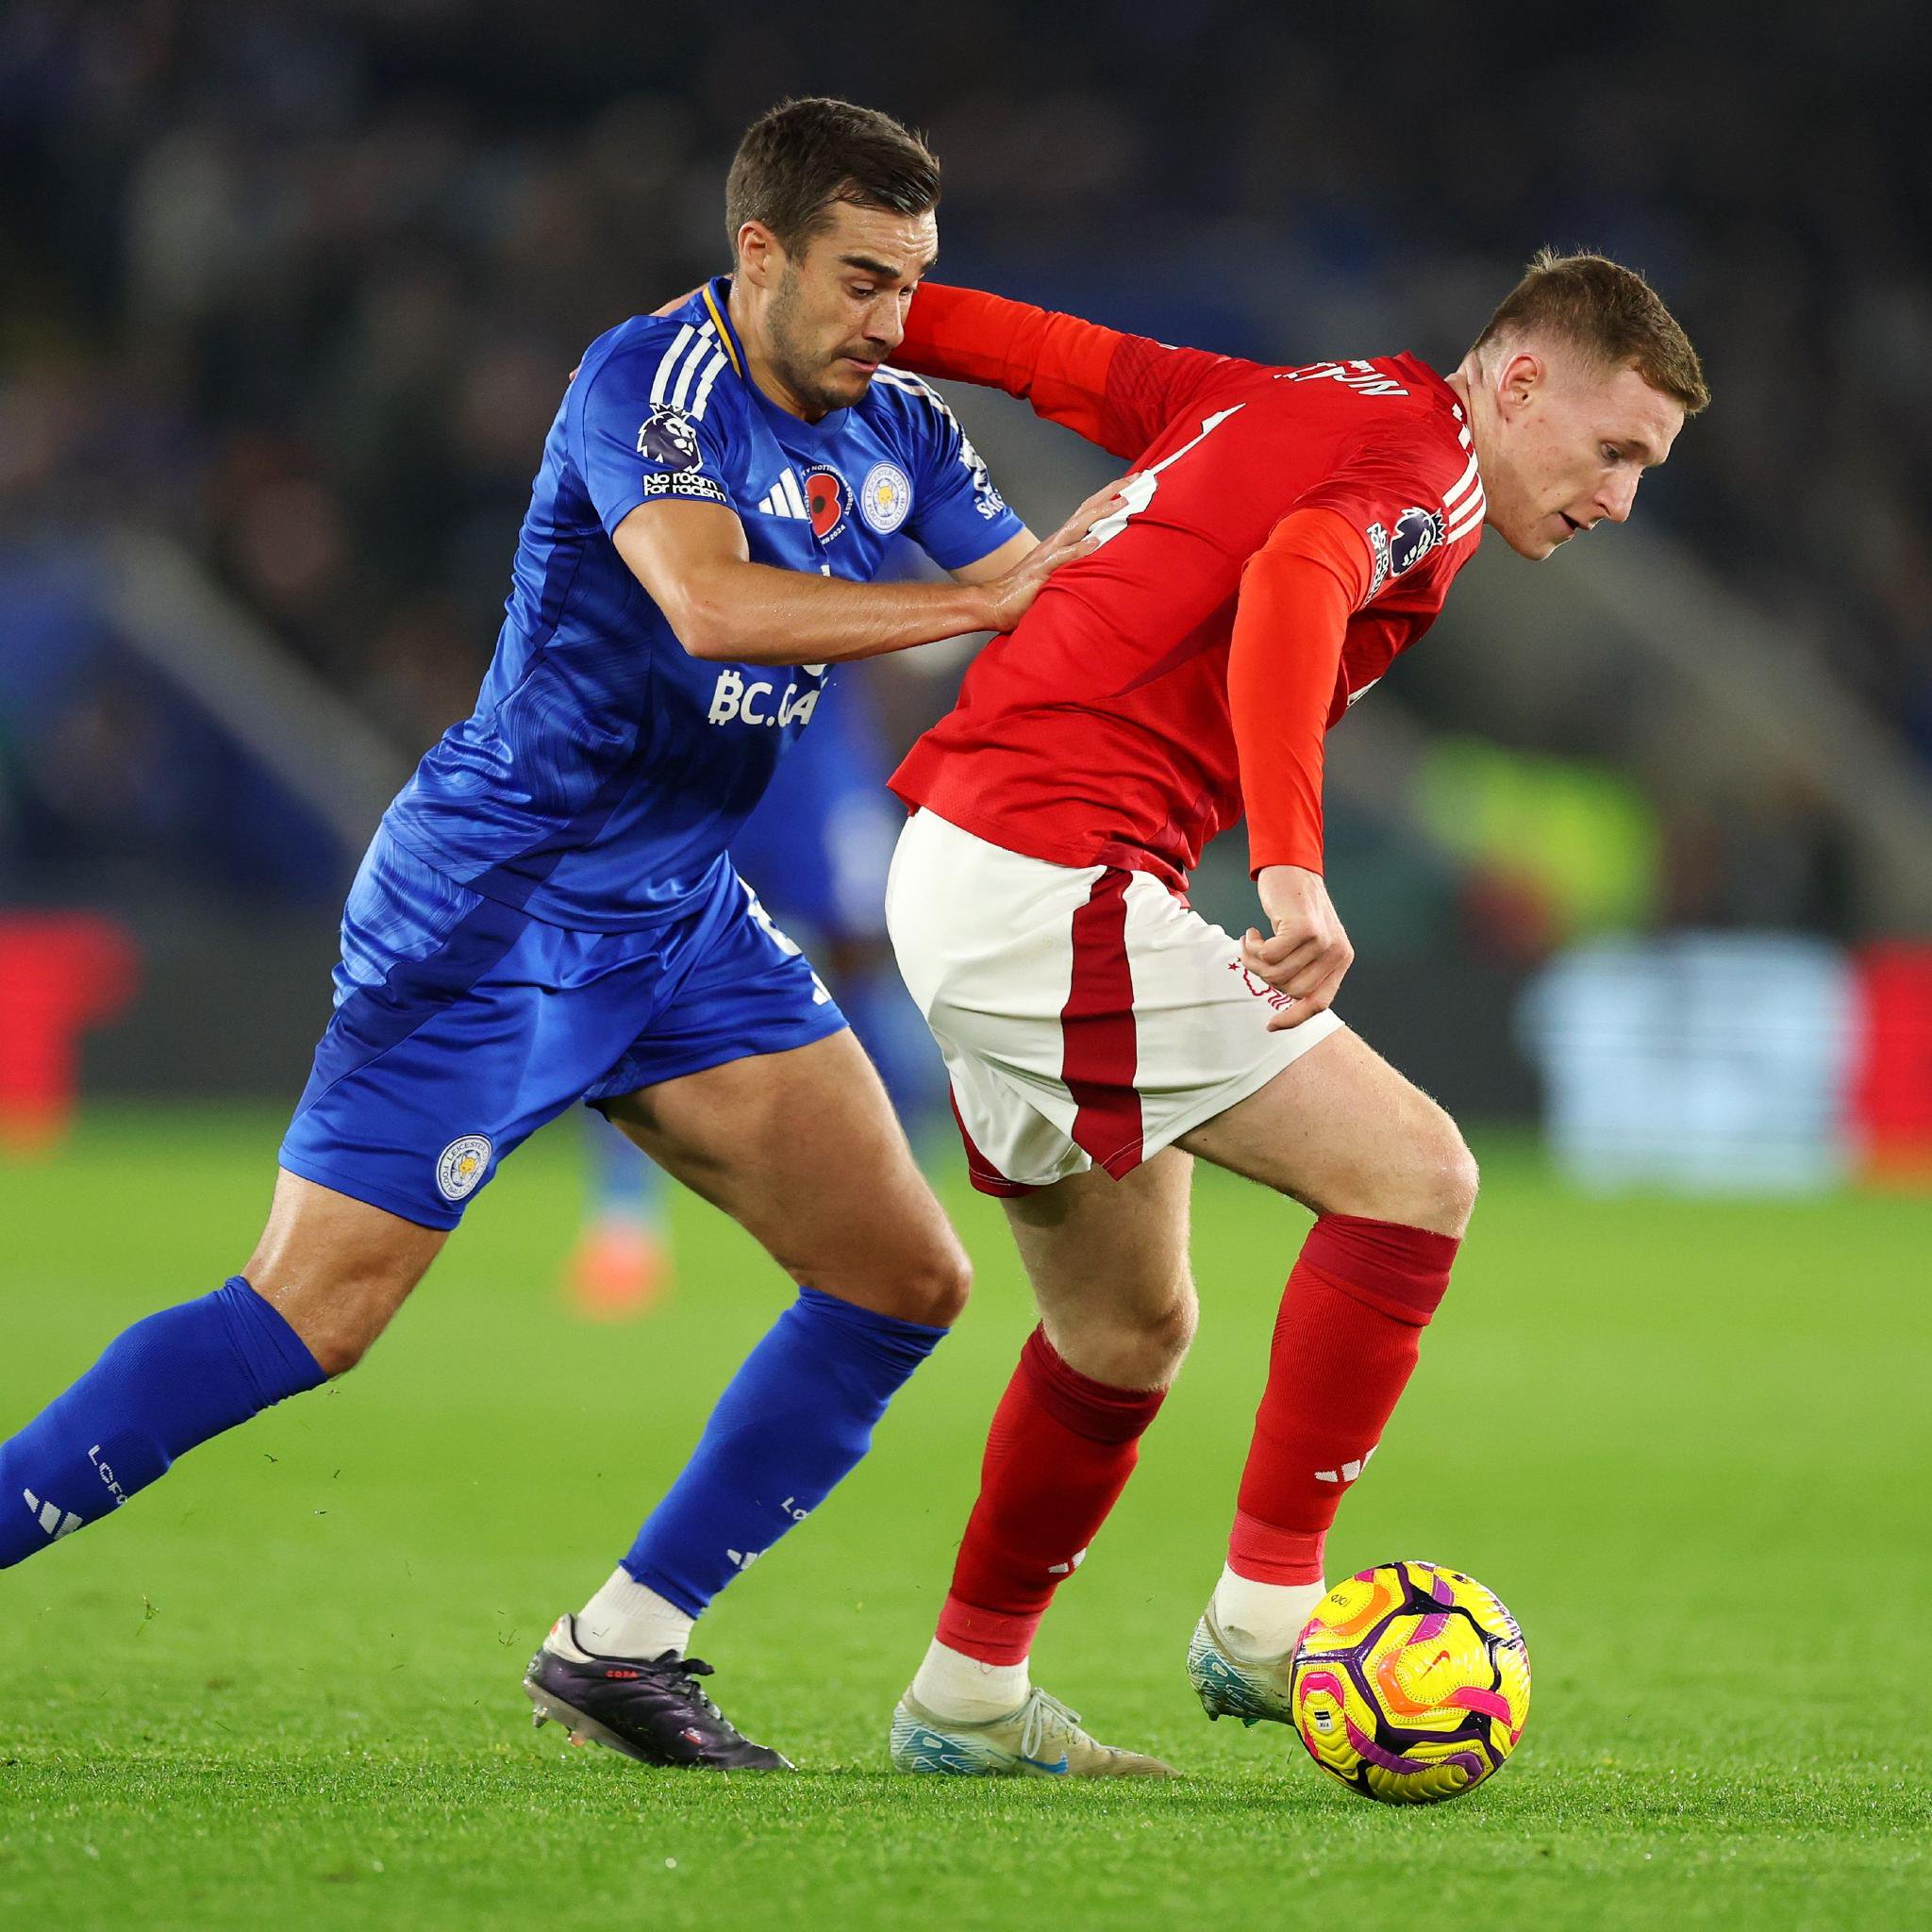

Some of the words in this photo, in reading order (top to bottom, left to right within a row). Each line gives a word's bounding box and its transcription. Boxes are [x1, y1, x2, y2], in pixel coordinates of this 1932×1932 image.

[643, 474, 670, 487] No
[673, 472, 718, 491] room
[673, 484, 726, 502] racism
[606, 1670, 639, 1678] COPA
